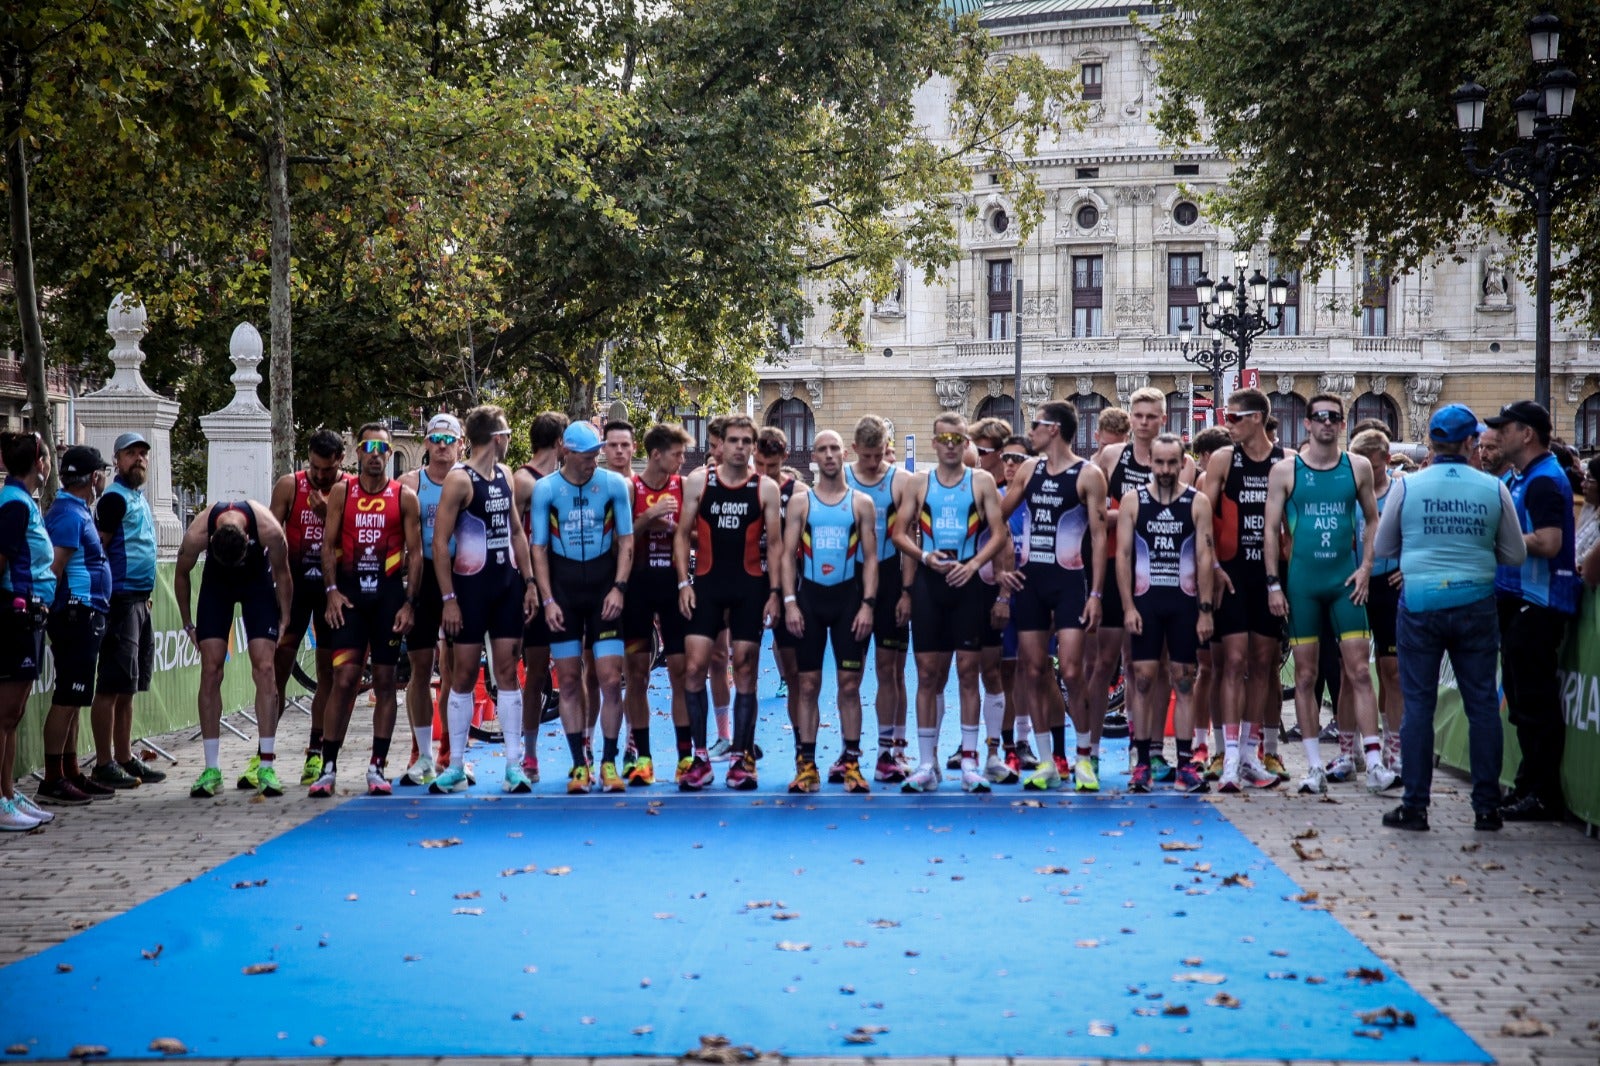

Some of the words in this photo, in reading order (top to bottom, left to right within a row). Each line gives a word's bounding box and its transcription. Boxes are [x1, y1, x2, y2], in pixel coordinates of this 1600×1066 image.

[1238, 490, 1267, 503] CREME
[721, 502, 749, 515] GROOT
[1034, 508, 1052, 523] FRA
[1304, 502, 1346, 516] MILEHAM
[355, 513, 385, 528] MARTIN
[491, 513, 505, 528] FRA
[717, 515, 740, 529] NED
[935, 518, 964, 530] BEL
[1146, 520, 1184, 534] CHOQUERT
[1243, 515, 1264, 530] NED
[1313, 516, 1338, 530] AUS
[1422, 516, 1487, 527] TECHNICAL
[304, 526, 325, 540] ES
[358, 529, 381, 543] ESP
[1423, 525, 1487, 537] DELEGATE
[815, 537, 845, 549] BEL
[1153, 536, 1175, 550] FRA
[649, 558, 671, 568] tribe
